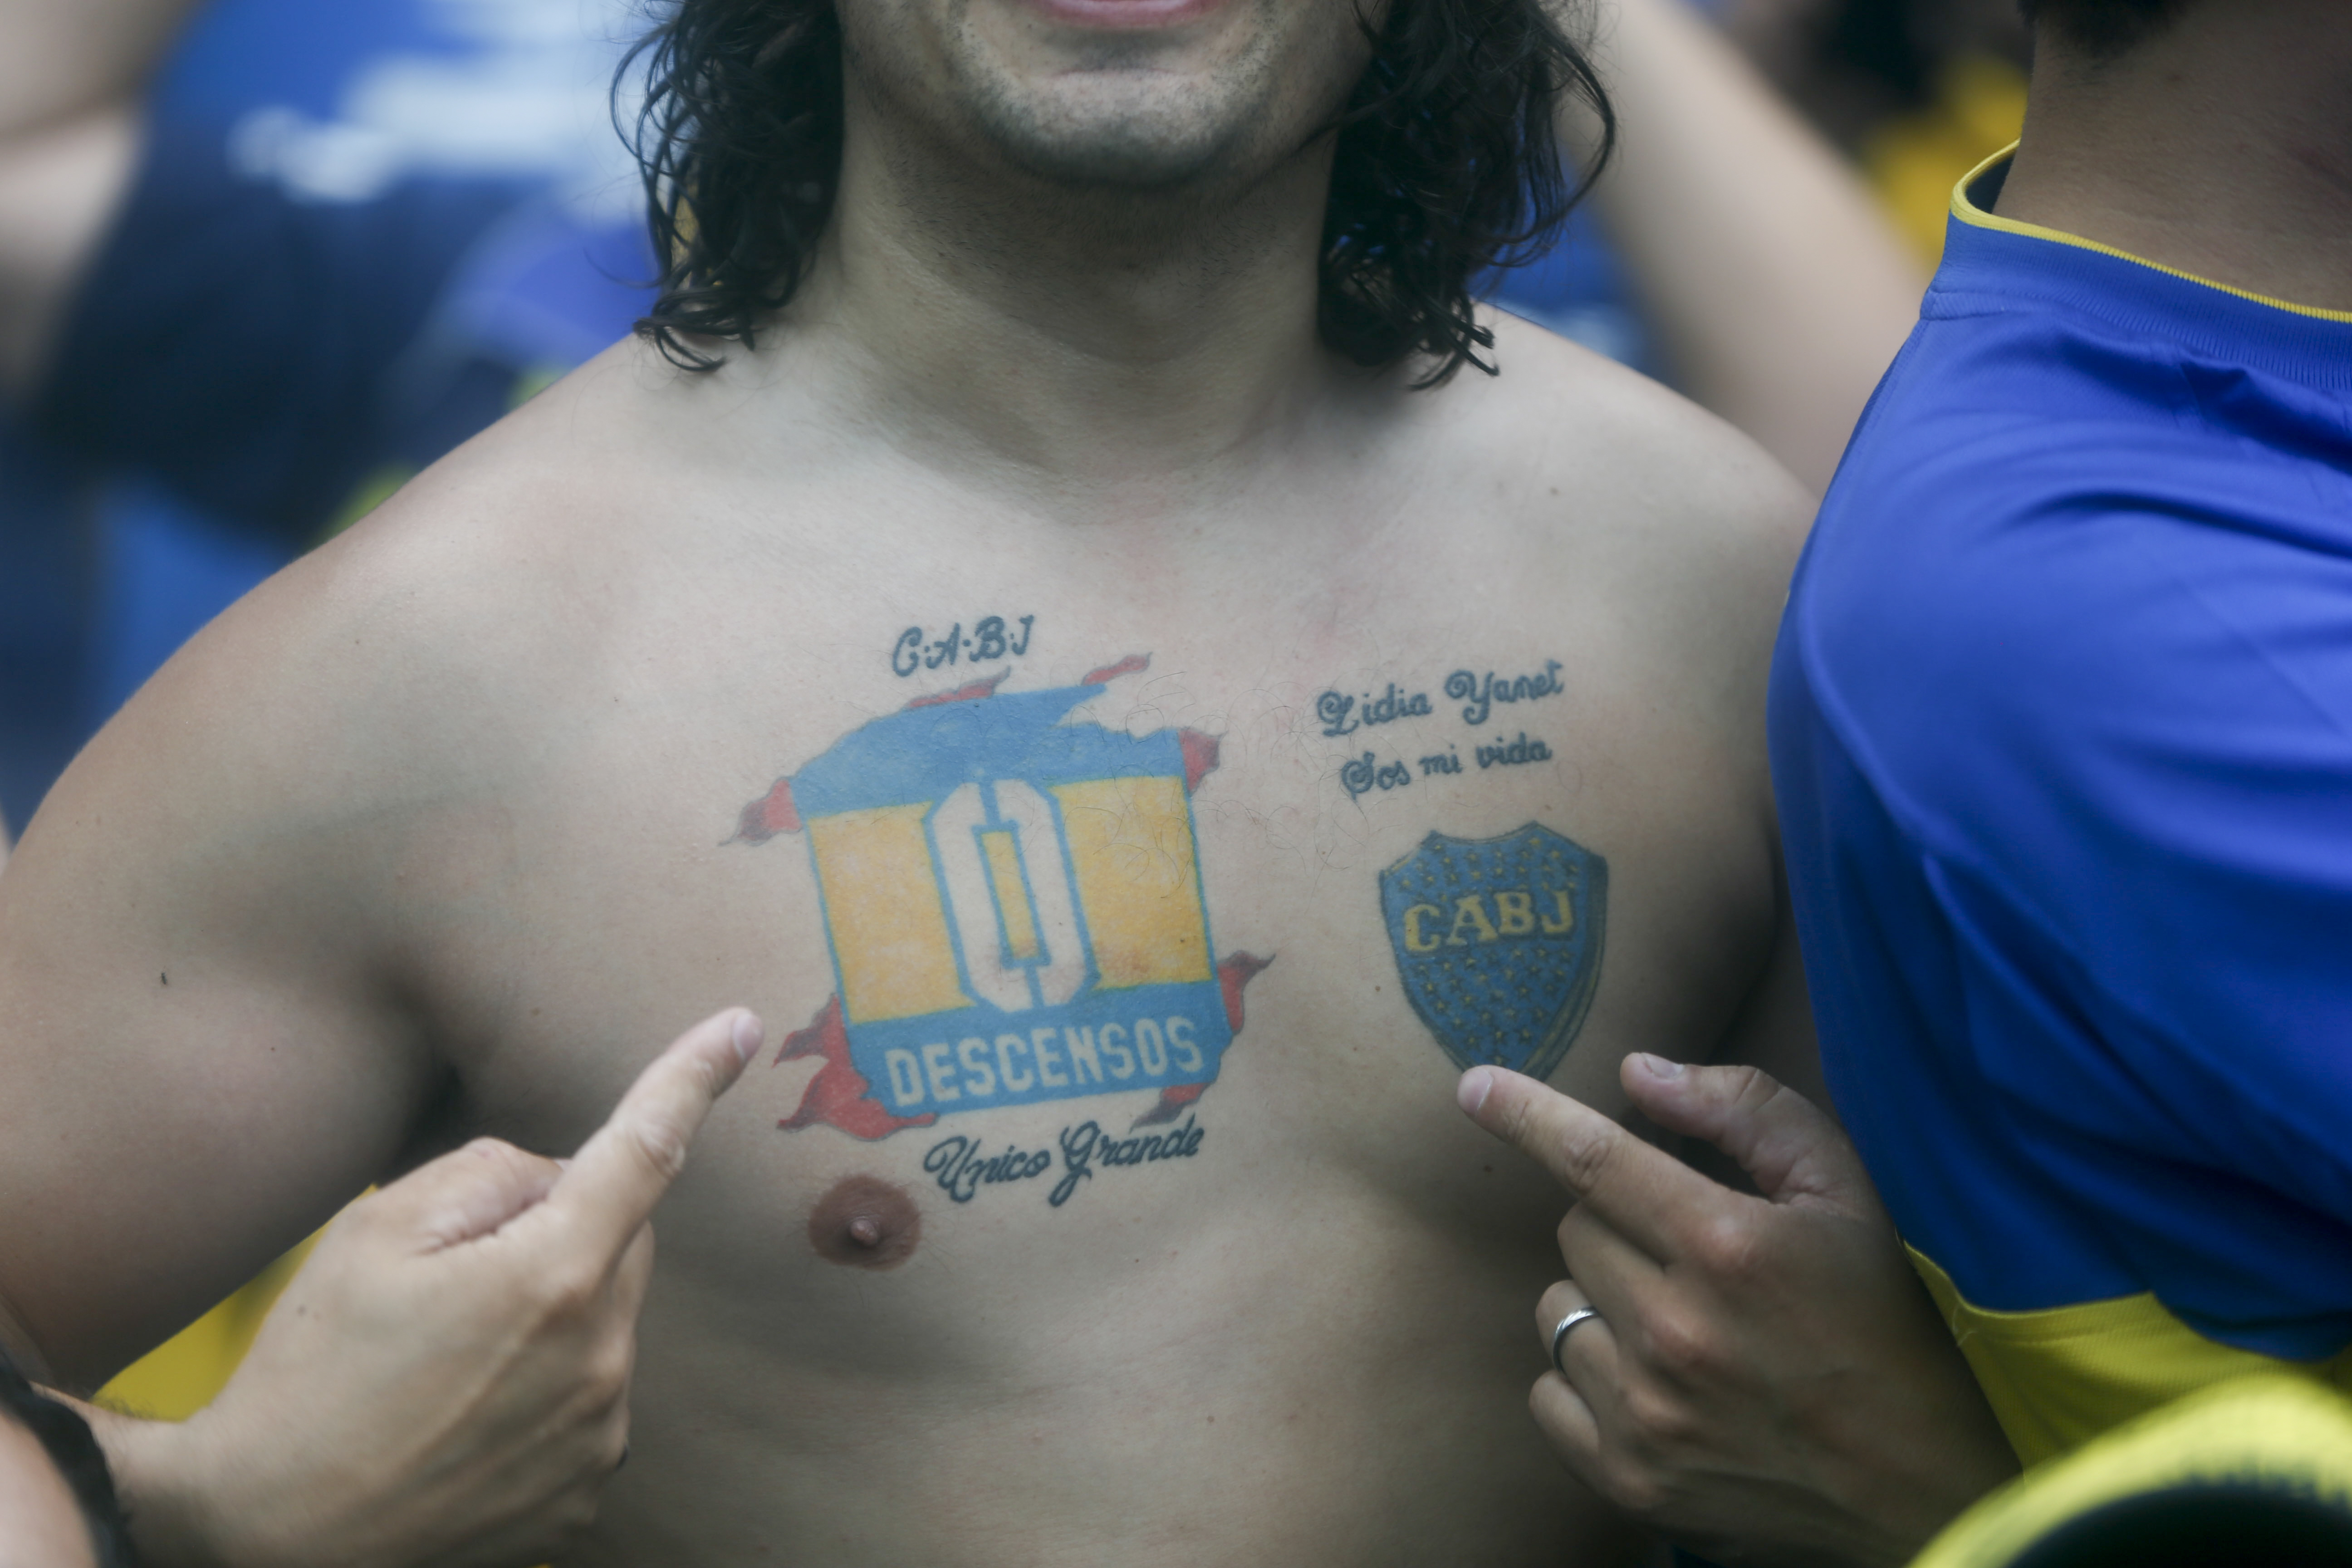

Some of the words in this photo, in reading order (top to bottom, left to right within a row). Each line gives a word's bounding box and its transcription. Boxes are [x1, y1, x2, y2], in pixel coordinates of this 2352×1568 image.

[1317, 682, 1433, 737] Lidia
[1444, 659, 1564, 725] Yanet
[1341, 751, 1411, 802] Sos
[1418, 743, 1464, 776] mi
[1475, 731, 1553, 769] vida
[1403, 890, 1574, 952] CABJ
[884, 1017, 1204, 1107] DESCENSOS
[923, 1136, 1051, 1204] Unico
[1048, 1112, 1205, 1208] Grande
